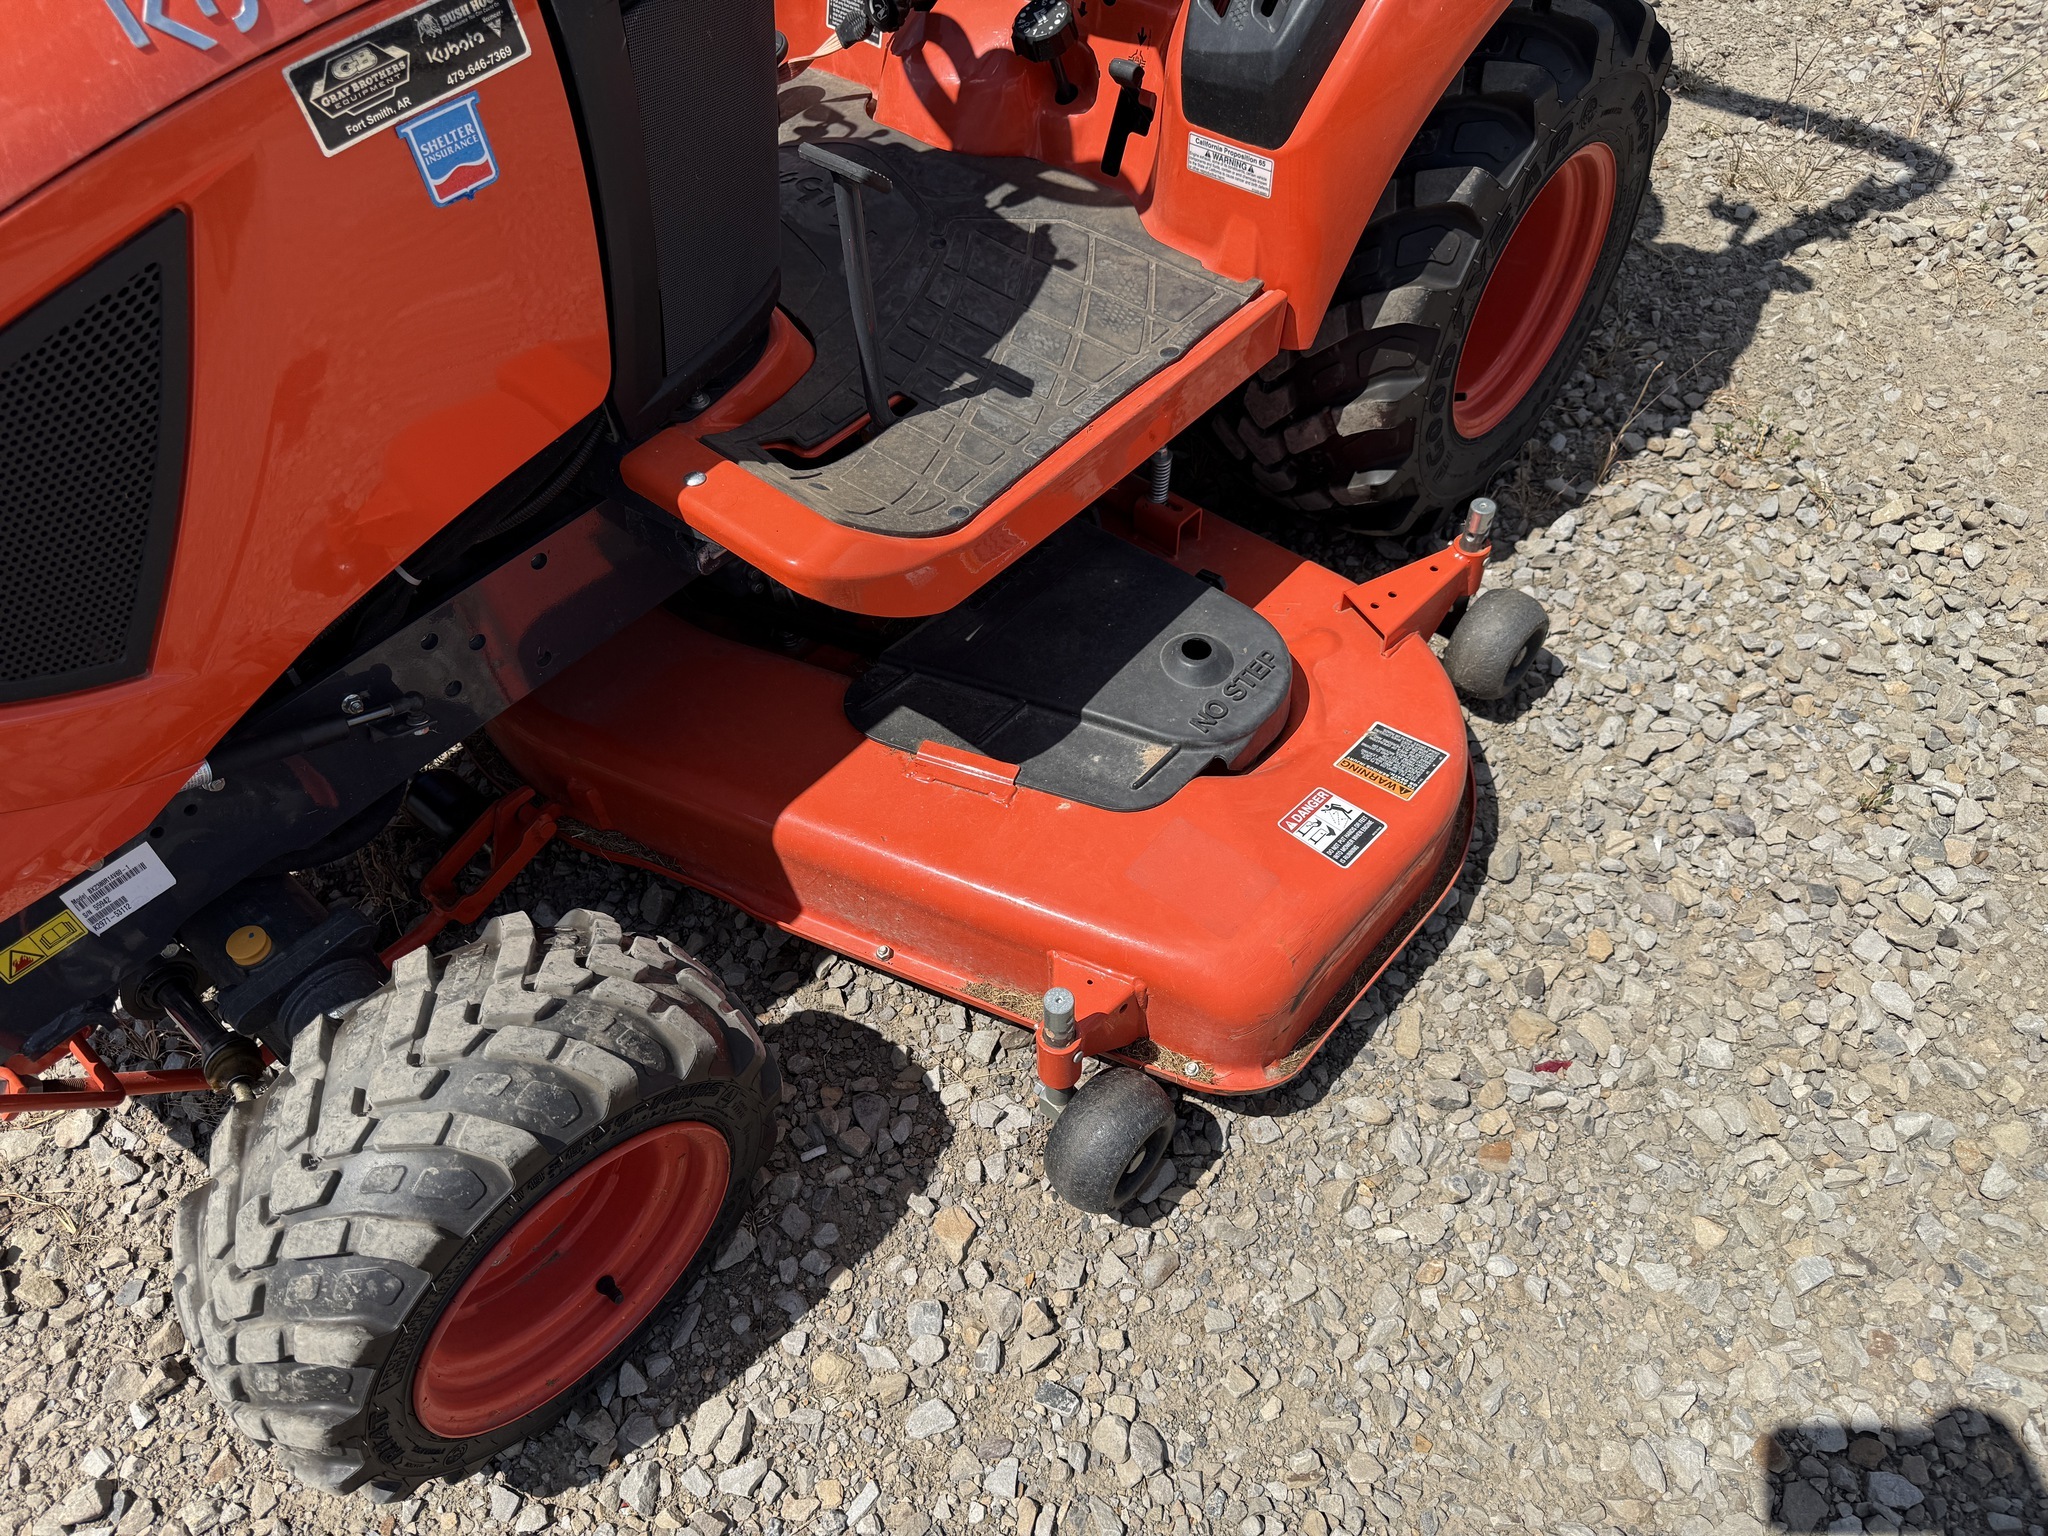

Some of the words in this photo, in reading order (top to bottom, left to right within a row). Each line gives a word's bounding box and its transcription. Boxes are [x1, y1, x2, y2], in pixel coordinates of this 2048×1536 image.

[439, 4, 470, 26] BUSH
[426, 32, 484, 62] Kubota
[333, 49, 376, 78] GB
[447, 46, 511, 83] 479-646-7369
[321, 87, 349, 106] GRAY
[351, 61, 405, 91] BROTHERS
[334, 73, 399, 108] EQUIPMENT
[345, 119, 366, 134] Fort
[366, 106, 396, 124] Smith,
[397, 96, 411, 109] AR
[420, 123, 475, 156] SHELTER
[425, 134, 479, 165] INSURANCE
[1195, 137, 1222, 151] California
[1223, 147, 1257, 163] Proposition
[1212, 152, 1246, 170] WARNING
[1188, 700, 1229, 734] NO
[1222, 649, 1276, 702] STEP
[1340, 760, 1395, 790] WARNING
[1291, 791, 1328, 822] DANGER
[1337, 836, 1346, 844] PUT
[70, 893, 87, 905] Model
[82, 909, 92, 918] S/N
[92, 896, 110, 910] 55942
[92, 903, 131, 930] K2971-53112
